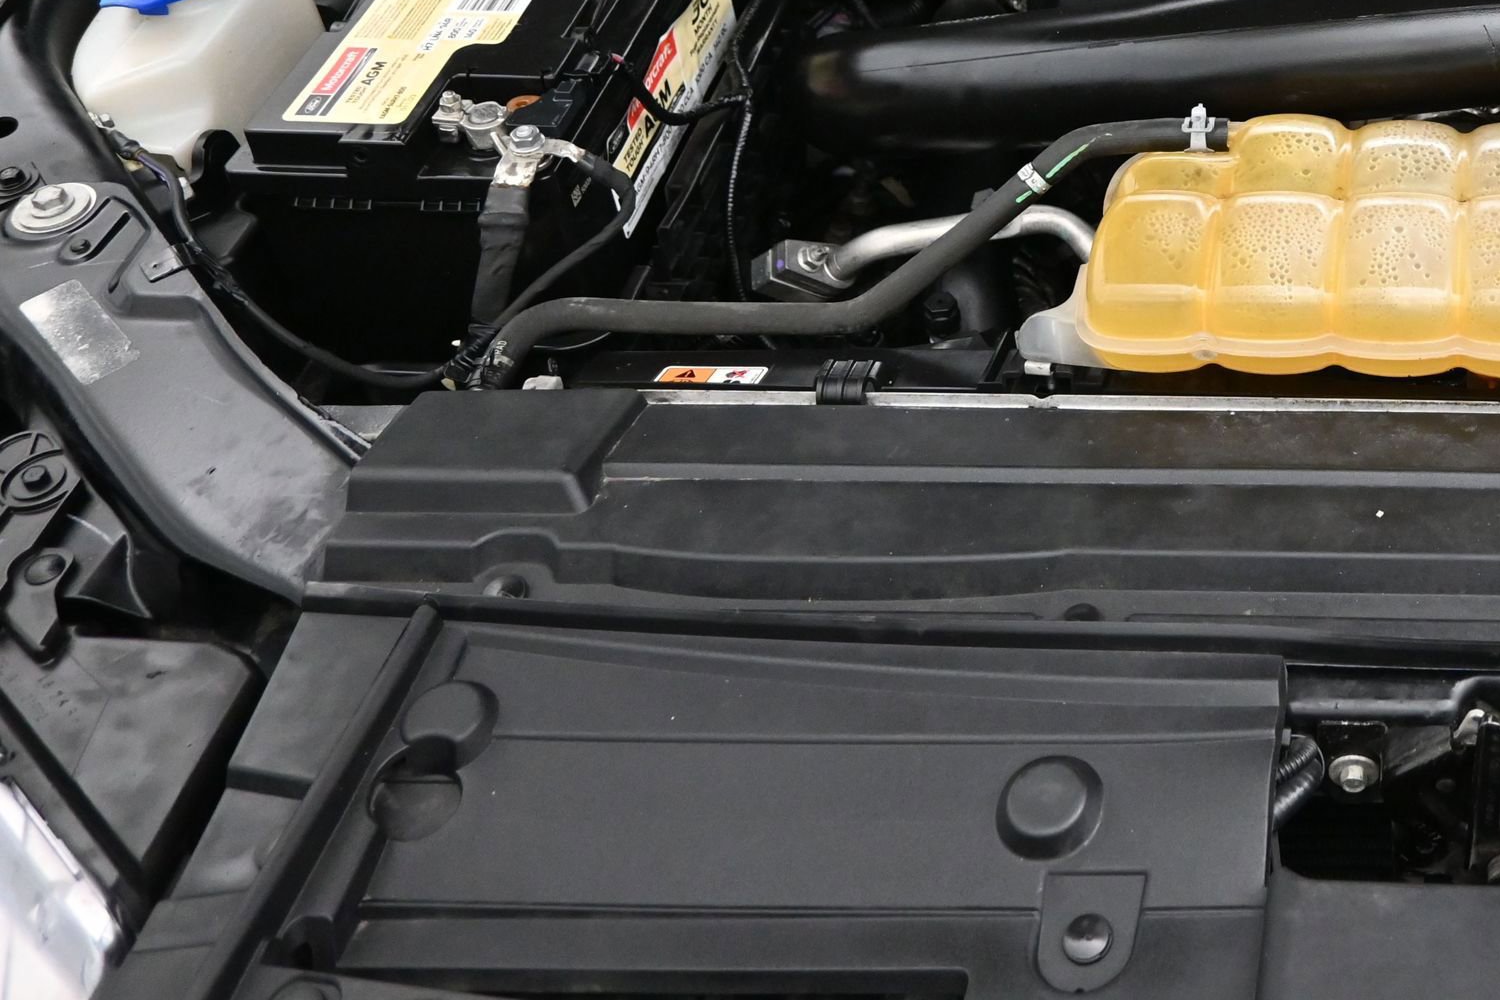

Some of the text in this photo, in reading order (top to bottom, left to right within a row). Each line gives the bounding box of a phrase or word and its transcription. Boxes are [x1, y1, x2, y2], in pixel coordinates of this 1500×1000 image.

[694, 3, 712, 34] MONTH
[320, 51, 360, 91] Motorcraft
[361, 61, 388, 86] AGM
[624, 128, 642, 162] TESTED
